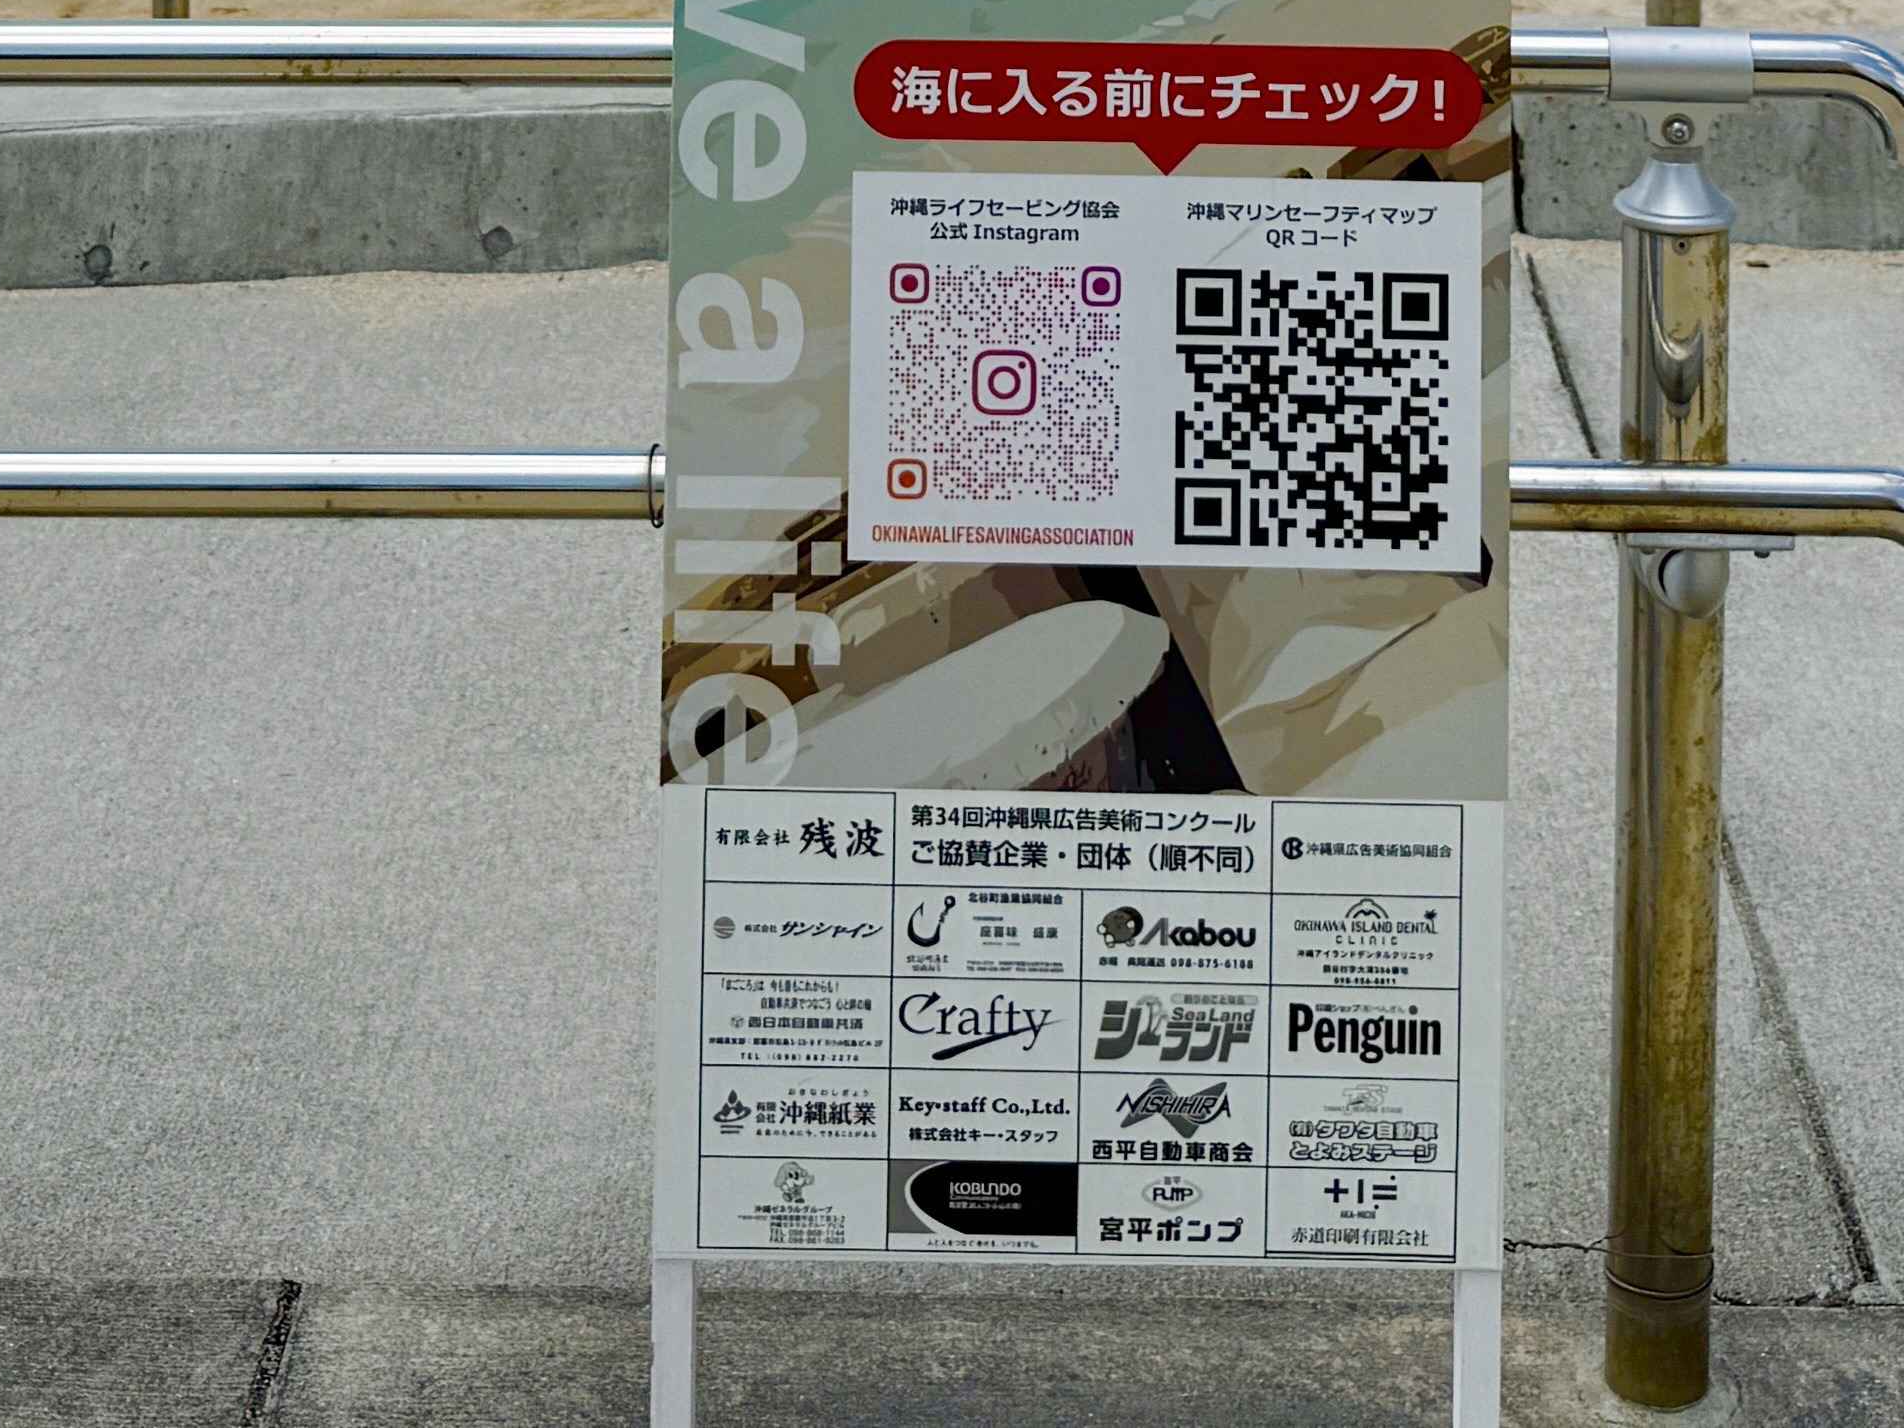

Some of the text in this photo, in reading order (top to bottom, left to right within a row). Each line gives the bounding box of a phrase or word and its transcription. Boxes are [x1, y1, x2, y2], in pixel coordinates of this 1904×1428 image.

[890, 195, 1121, 220] 沖縄ライフセービング協会
[1186, 201, 1439, 227] 沖縄マリンセーフティマップ
[929, 221, 1081, 245] 公式 Instagram
[1265, 228, 1359, 248] QR コード
[676, 276, 805, 391] a
[871, 524, 1135, 548] OKINAWALIFESAVINGASSOCIATION
[669, 475, 843, 785] life
[911, 804, 1257, 834] 第34回沖縄県広告美術コンクール
[715, 816, 886, 860] 有限会社 残波
[780, 920, 884, 939] サンシャイン
[1139, 916, 1257, 948] Akabou
[1294, 918, 1440, 935] OKINAWA ISLAND DENTAL
[899, 991, 1060, 1056] Crafty
[1288, 1002, 1442, 1064] Penguin
[779, 1100, 877, 1126] 沖縄紙業
[992, 1097, 1071, 1116] Co.,Ltd.
[1114, 1087, 1232, 1124] NISHIHIRA
[1091, 1139, 1255, 1163] 西平自動車商会
[1288, 1141, 1438, 1164] とよみステージ
[1099, 1215, 1245, 1243] 宮平ポンプ
[1291, 1226, 1431, 1247] 赤道印刷有限会社
